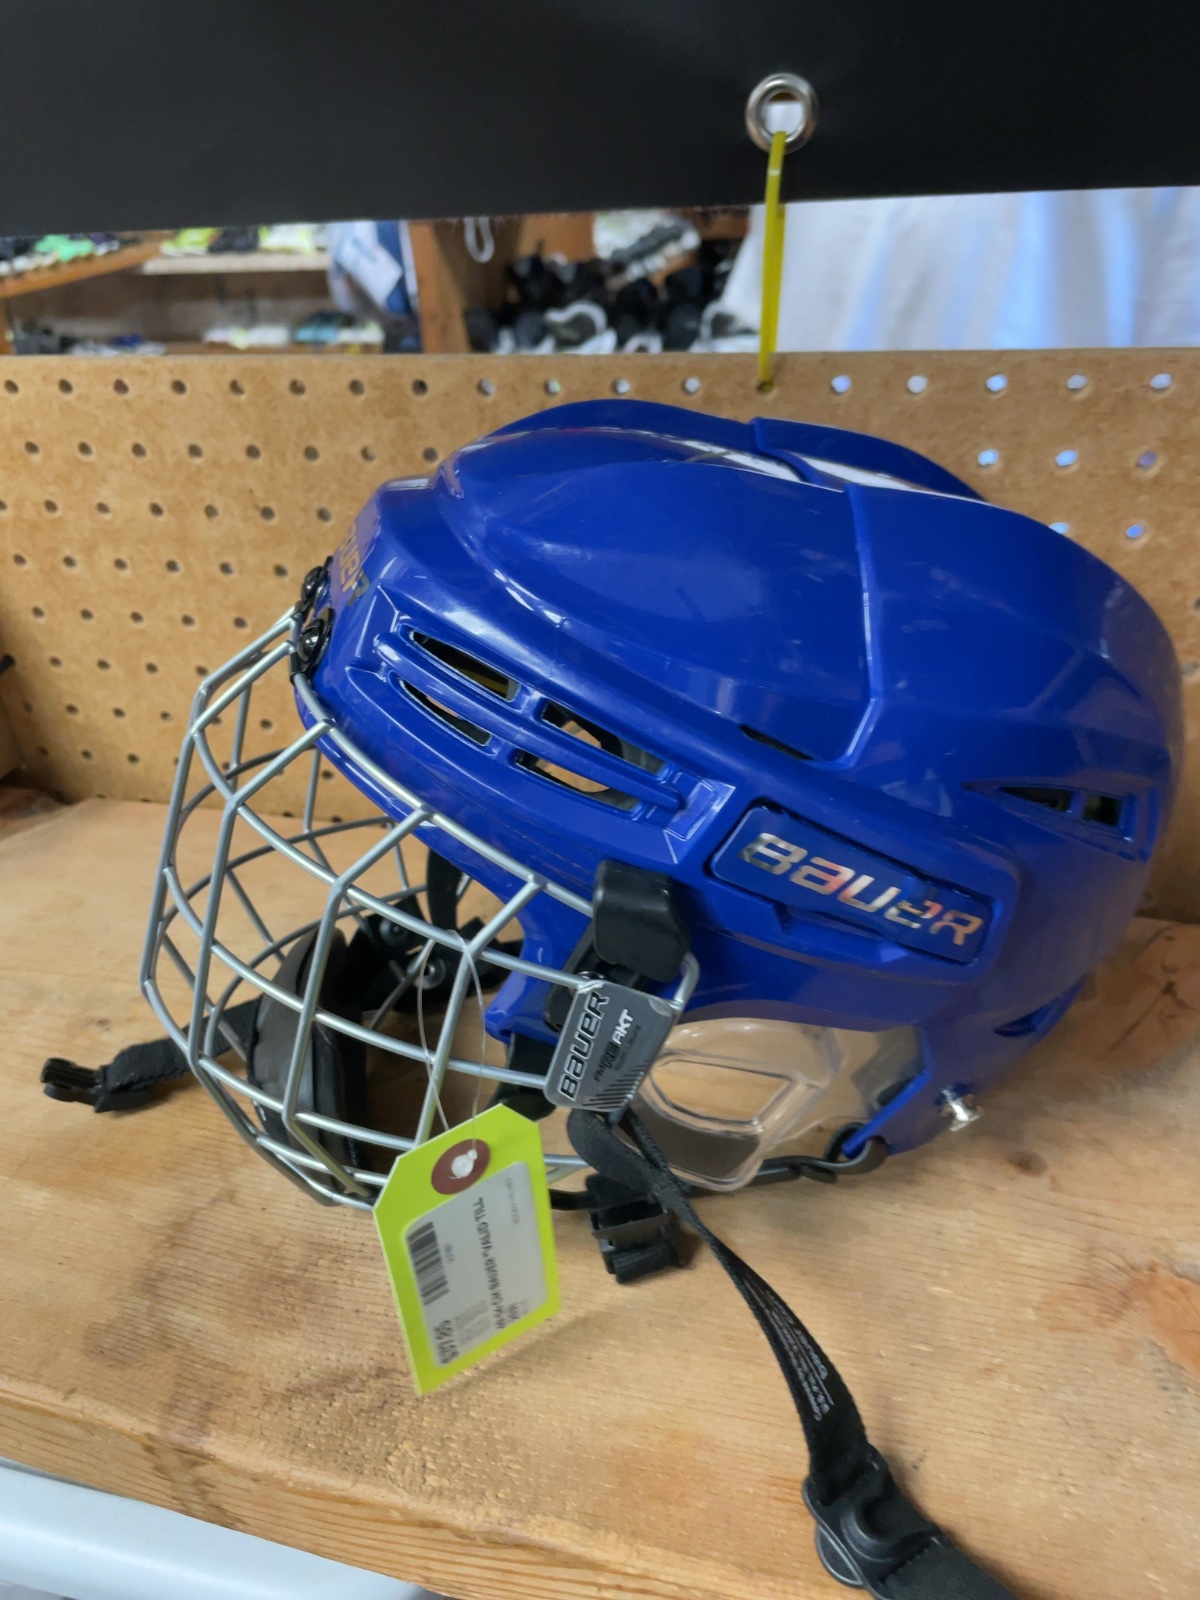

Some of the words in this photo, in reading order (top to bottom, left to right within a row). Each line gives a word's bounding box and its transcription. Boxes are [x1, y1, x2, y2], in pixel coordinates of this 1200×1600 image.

[739, 832, 984, 946] BAUER
[558, 991, 609, 1100] BAUER
[471, 1197, 486, 1221] TILL
